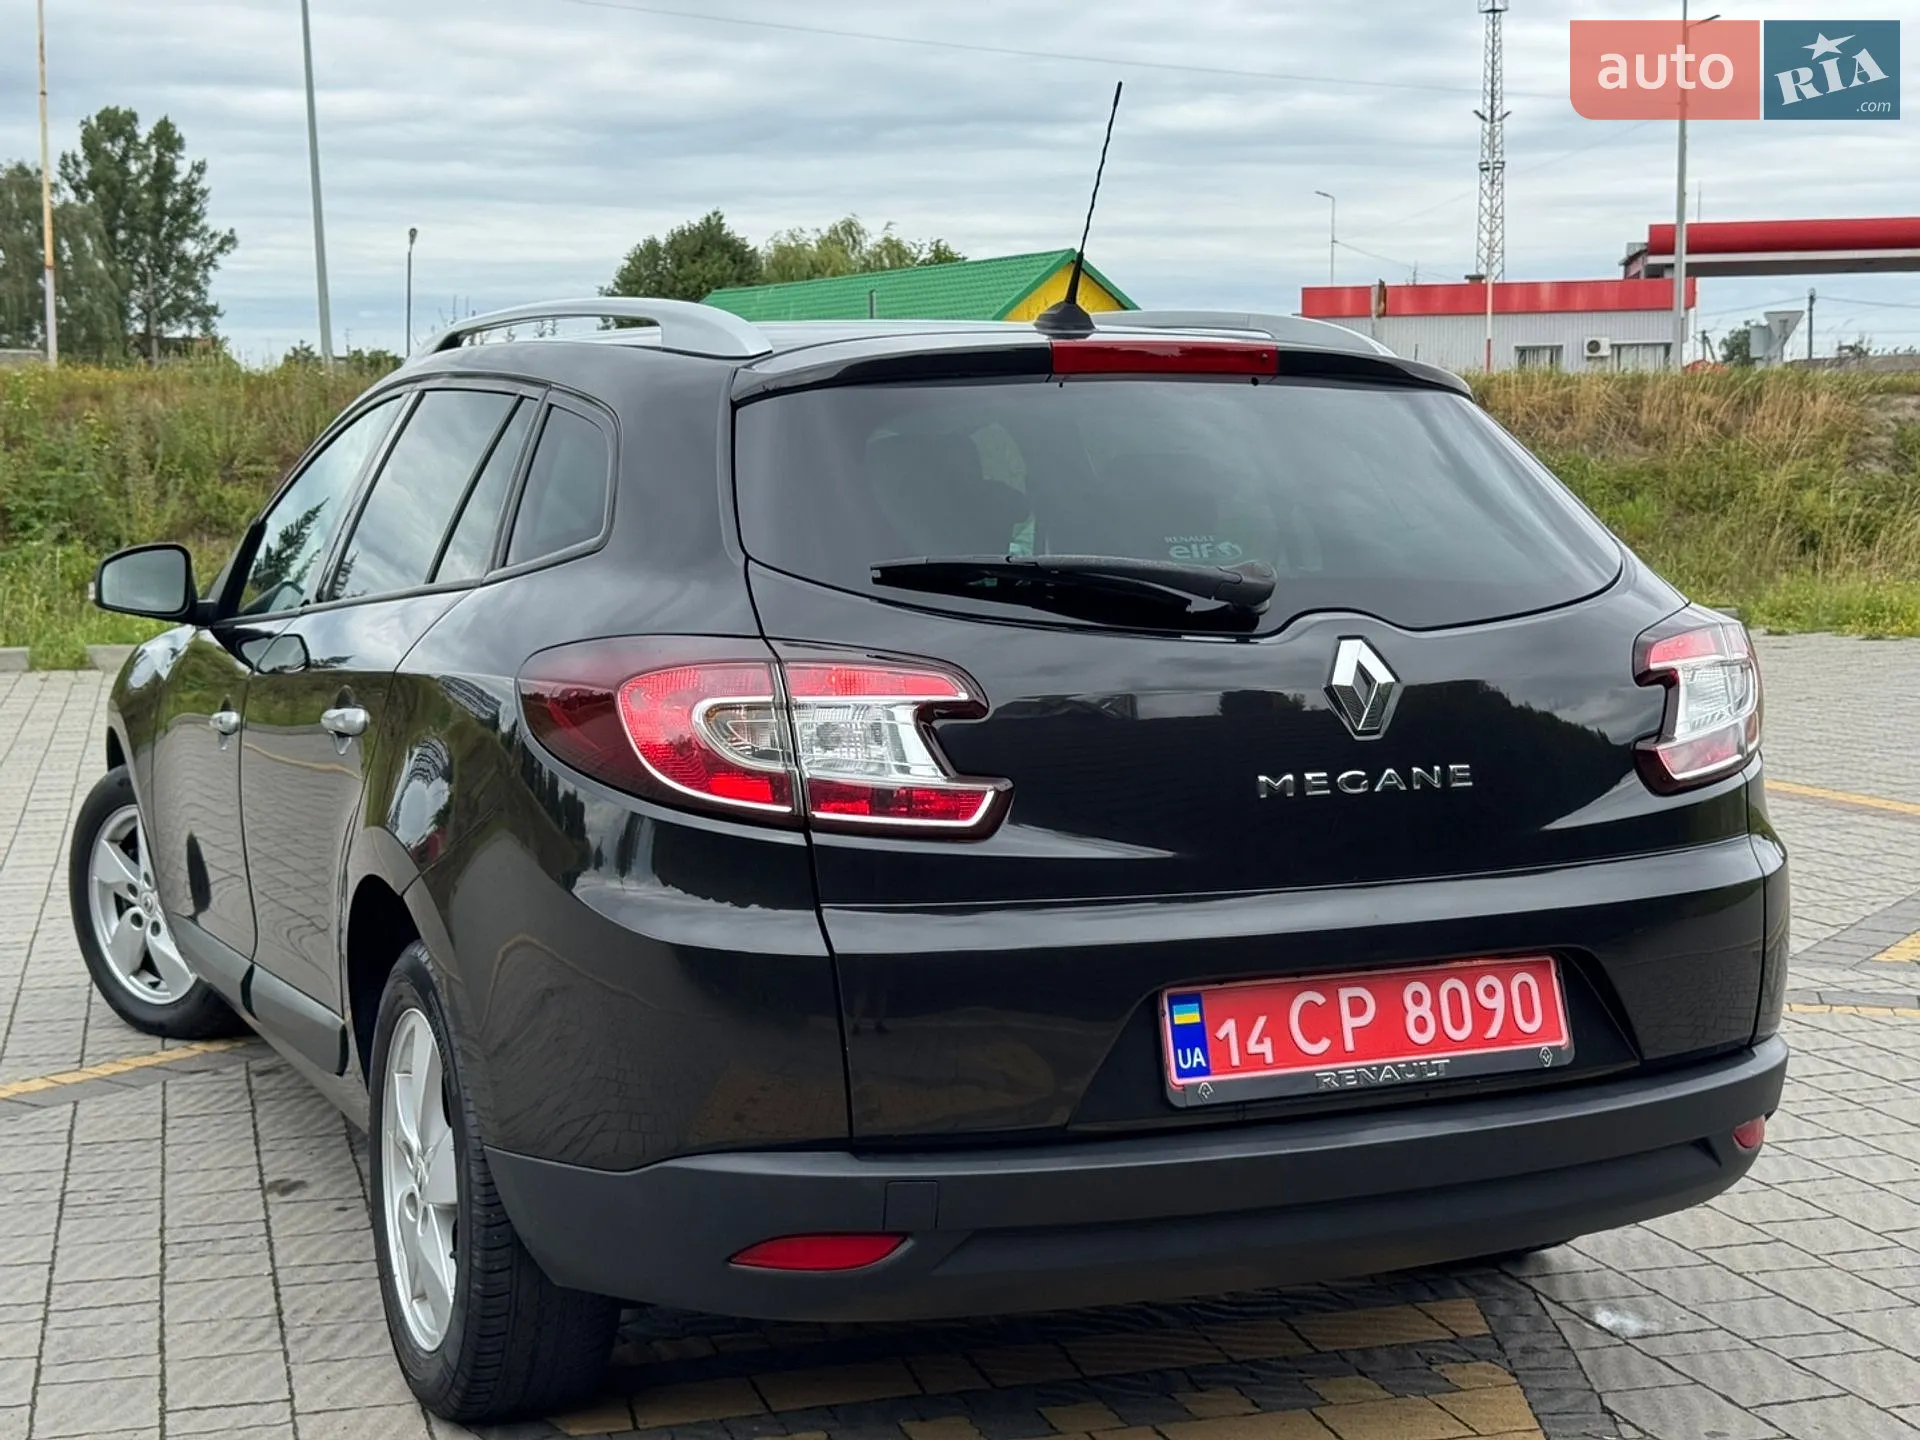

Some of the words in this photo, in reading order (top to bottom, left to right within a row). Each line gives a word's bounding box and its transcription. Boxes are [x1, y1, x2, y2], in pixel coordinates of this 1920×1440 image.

[1257, 763, 1474, 799] MEGANE
[1214, 1015, 1275, 1067] 14
[1287, 985, 1377, 1057] CP
[1402, 971, 1543, 1046] 8090
[1177, 1047, 1207, 1069] UA
[1314, 1059, 1451, 1090] RENAULT
